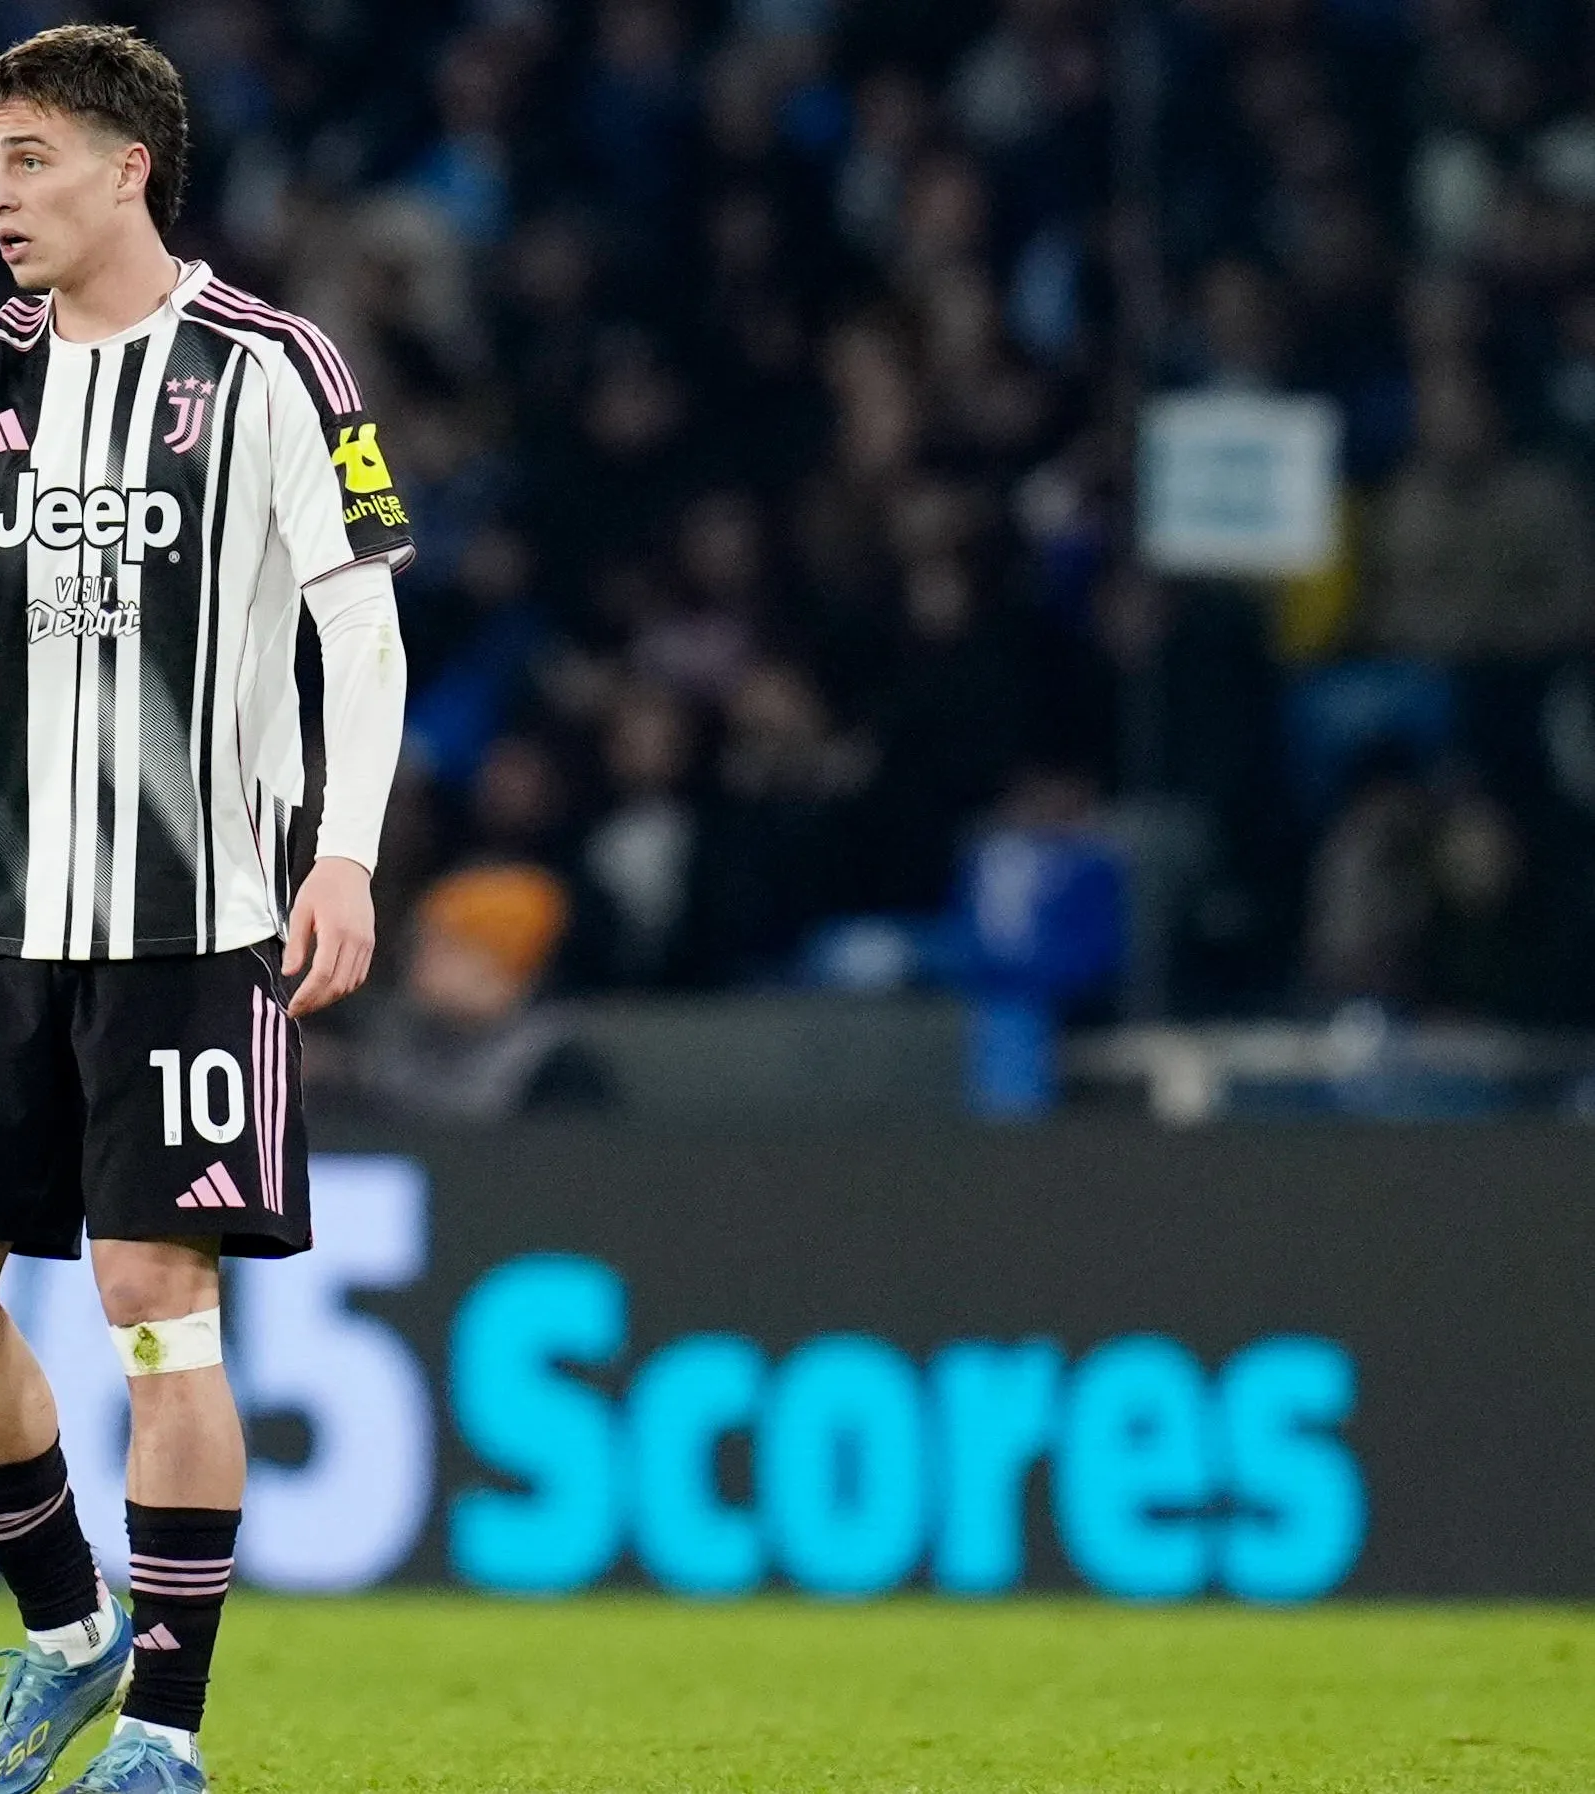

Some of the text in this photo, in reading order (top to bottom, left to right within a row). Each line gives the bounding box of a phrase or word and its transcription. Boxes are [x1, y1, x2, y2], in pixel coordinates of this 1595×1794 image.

[343, 494, 402, 524] white
[55, 576, 114, 603] VISIT
[26, 599, 141, 644] Detroit
[149, 1048, 246, 1147] 10
[446, 1250, 1366, 1603] Scores
